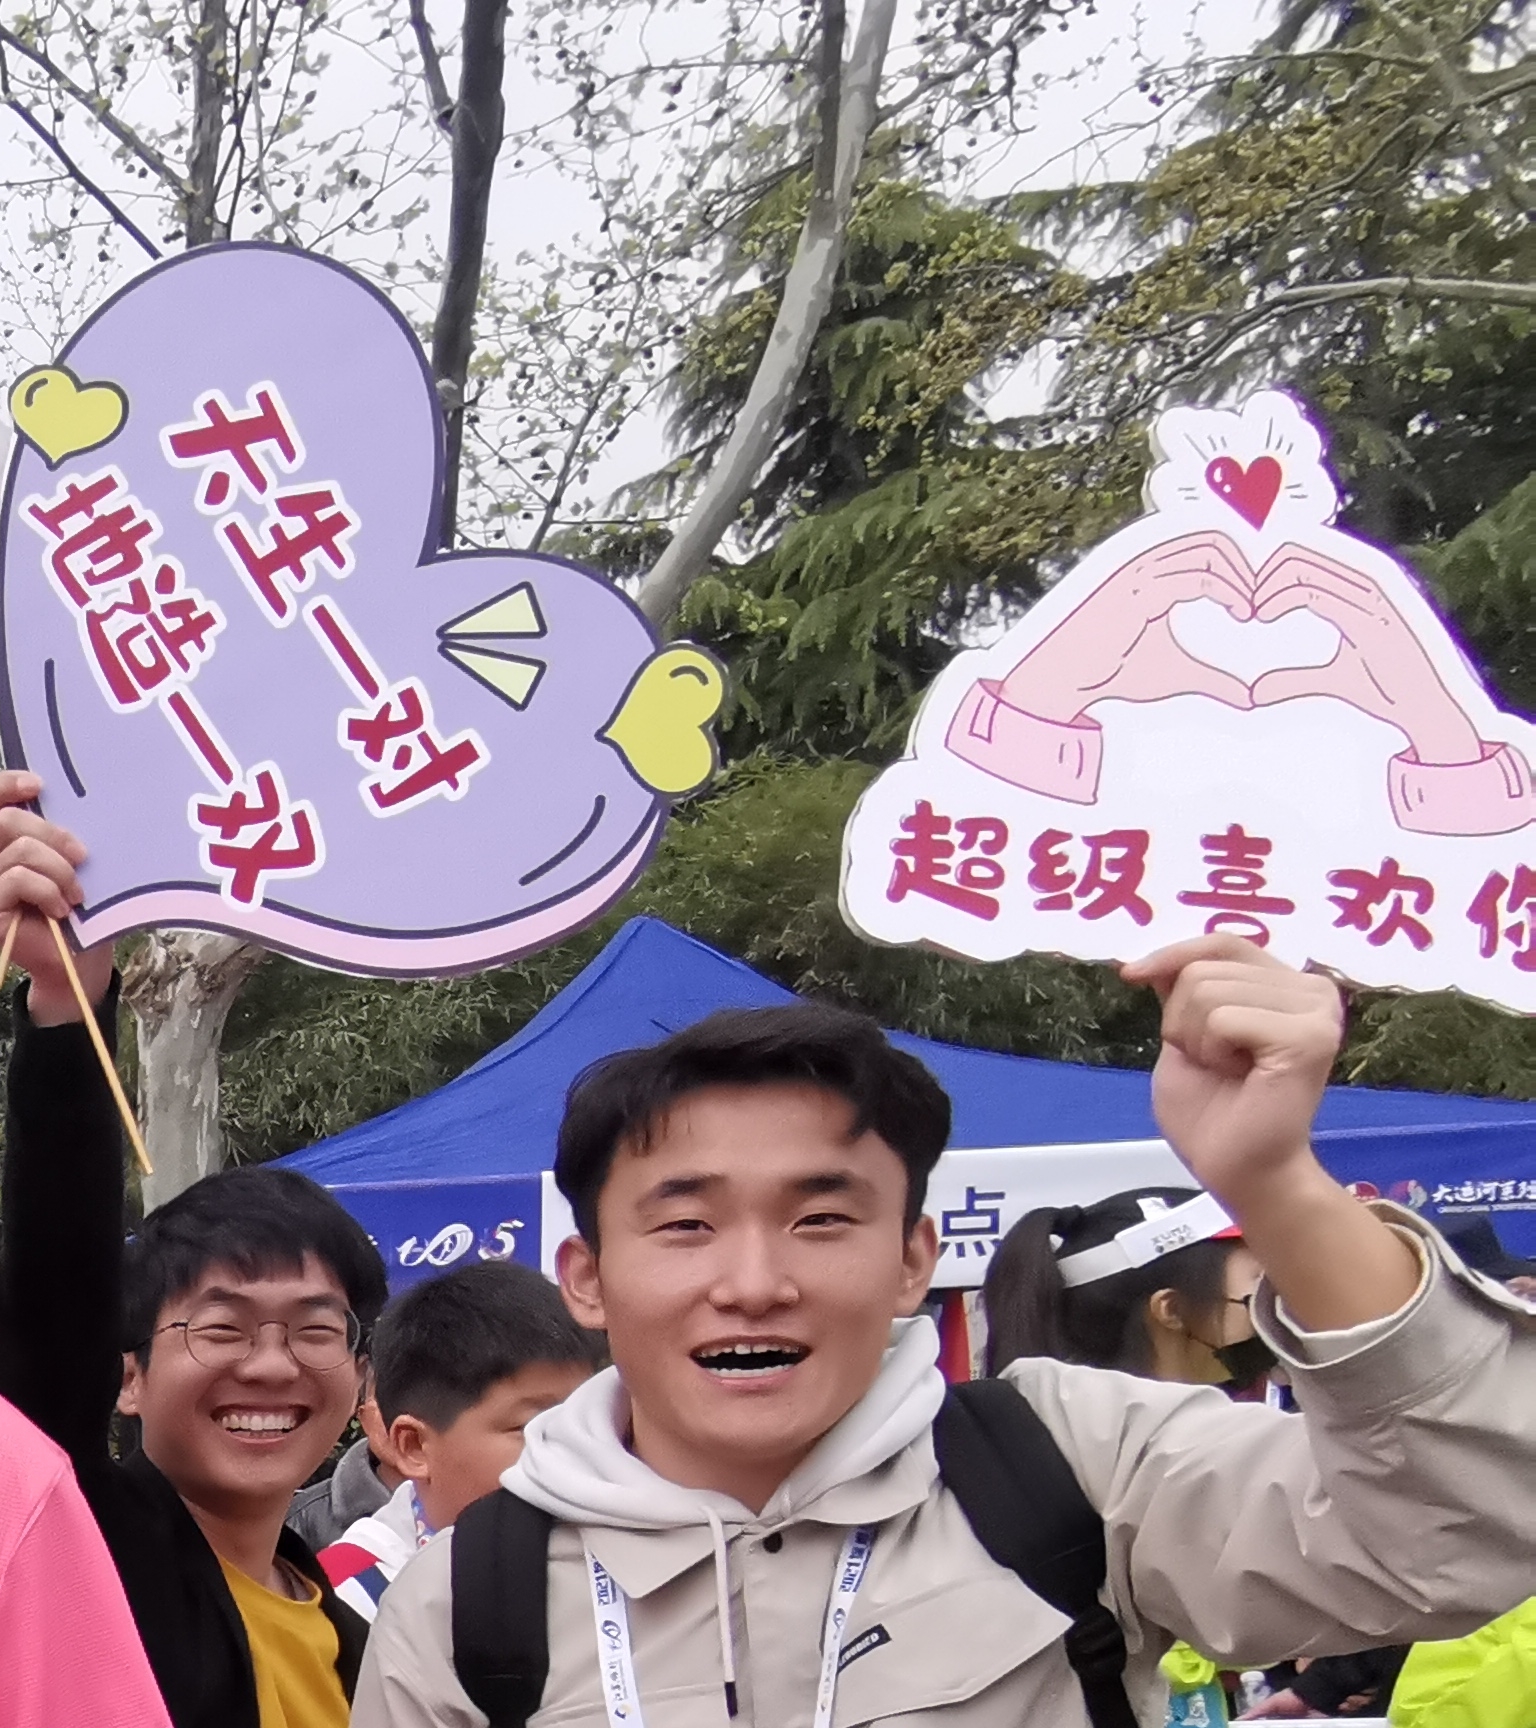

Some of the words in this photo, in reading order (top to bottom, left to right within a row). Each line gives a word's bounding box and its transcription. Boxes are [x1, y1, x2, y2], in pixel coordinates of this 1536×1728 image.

[29, 475, 317, 903] 地造一双
[168, 388, 481, 809] 天生一对
[939, 1186, 1005, 1260] 点
